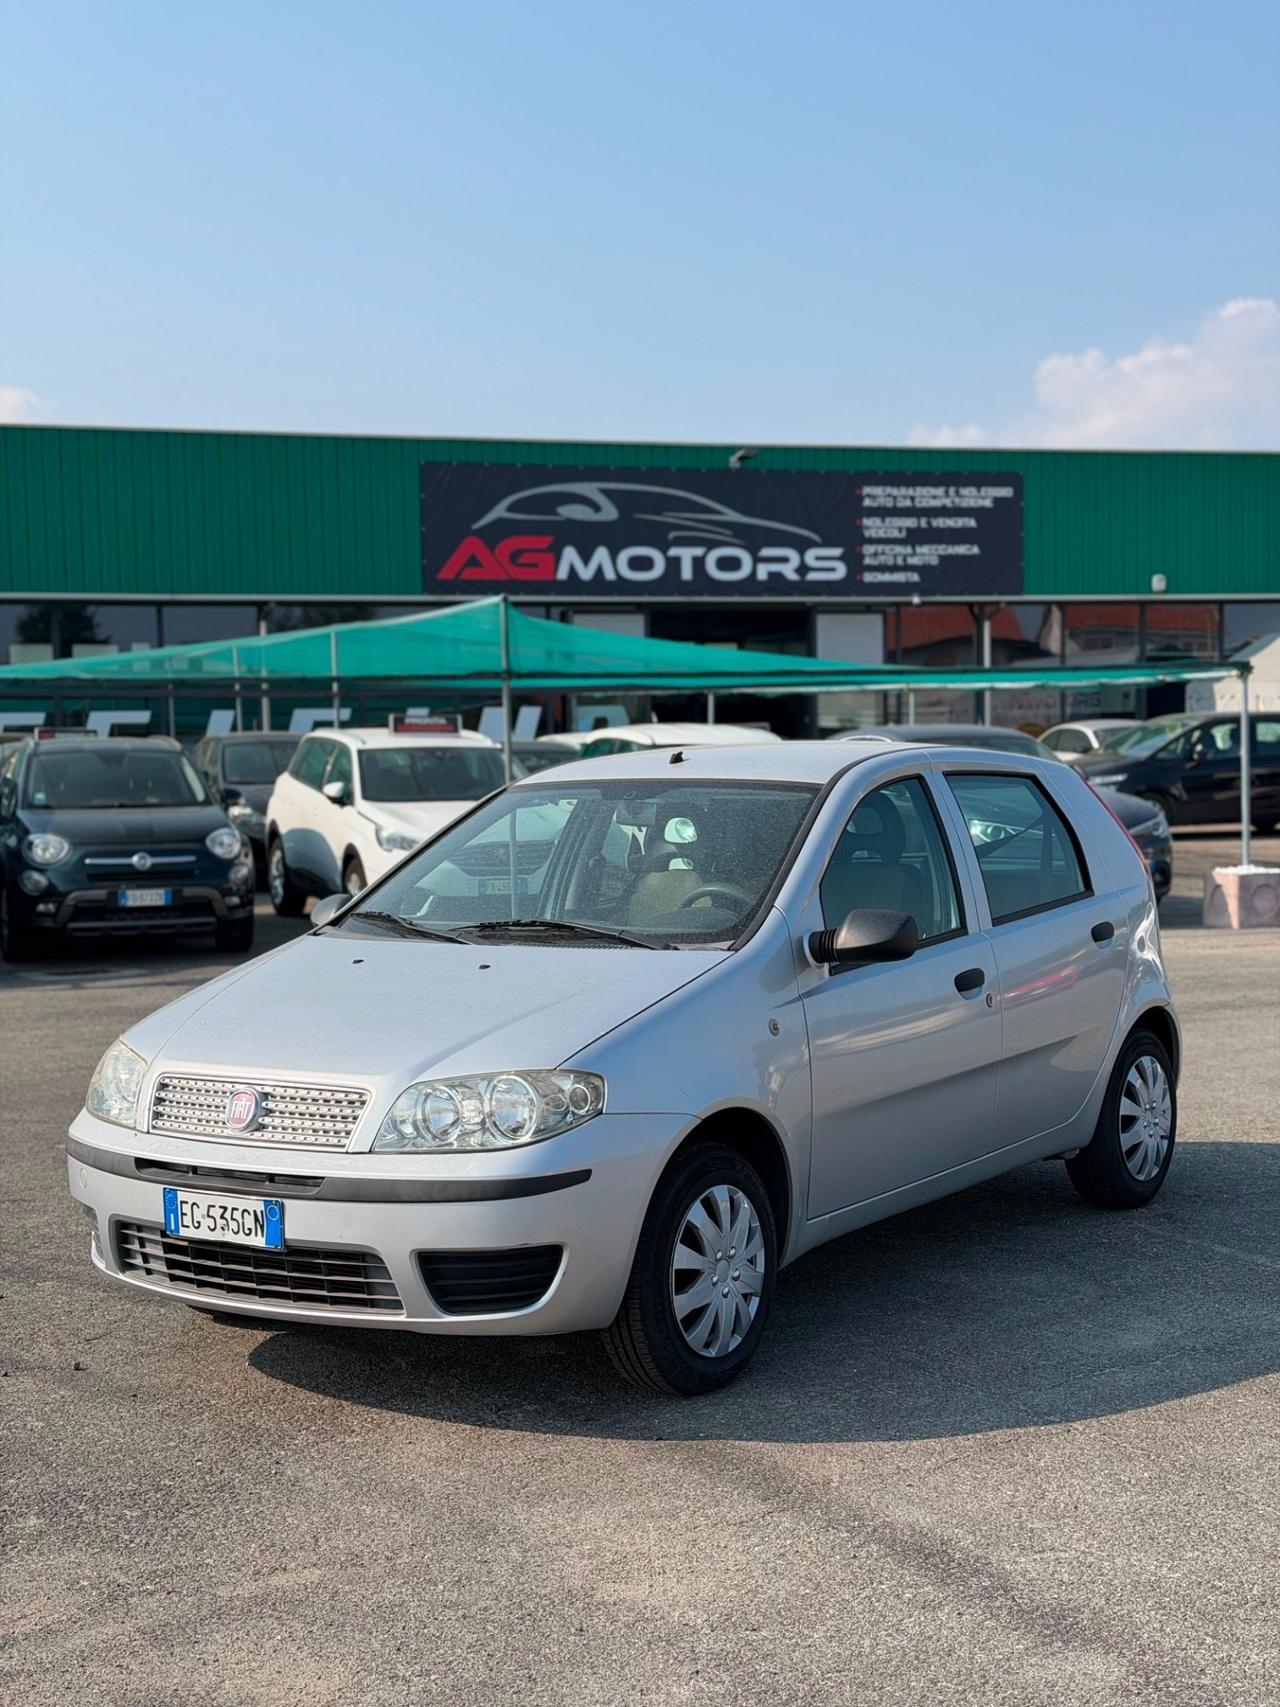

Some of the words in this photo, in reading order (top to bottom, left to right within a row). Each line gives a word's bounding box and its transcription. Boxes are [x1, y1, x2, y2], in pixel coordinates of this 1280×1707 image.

[862, 486, 945, 497] PREPARAZIONE
[947, 486, 956, 497] E
[862, 497, 894, 508] AUTO
[896, 497, 912, 508] DA
[914, 498, 994, 508] COMPETIZIONE
[919, 517, 928, 528] E
[862, 544, 913, 555] OFFICINA
[915, 544, 981, 556] MECCANICA
[863, 555, 895, 566] AUTO
[896, 555, 904, 566] E
[906, 555, 940, 566] MOTO
[230, 1098, 252, 1119] FIAT
